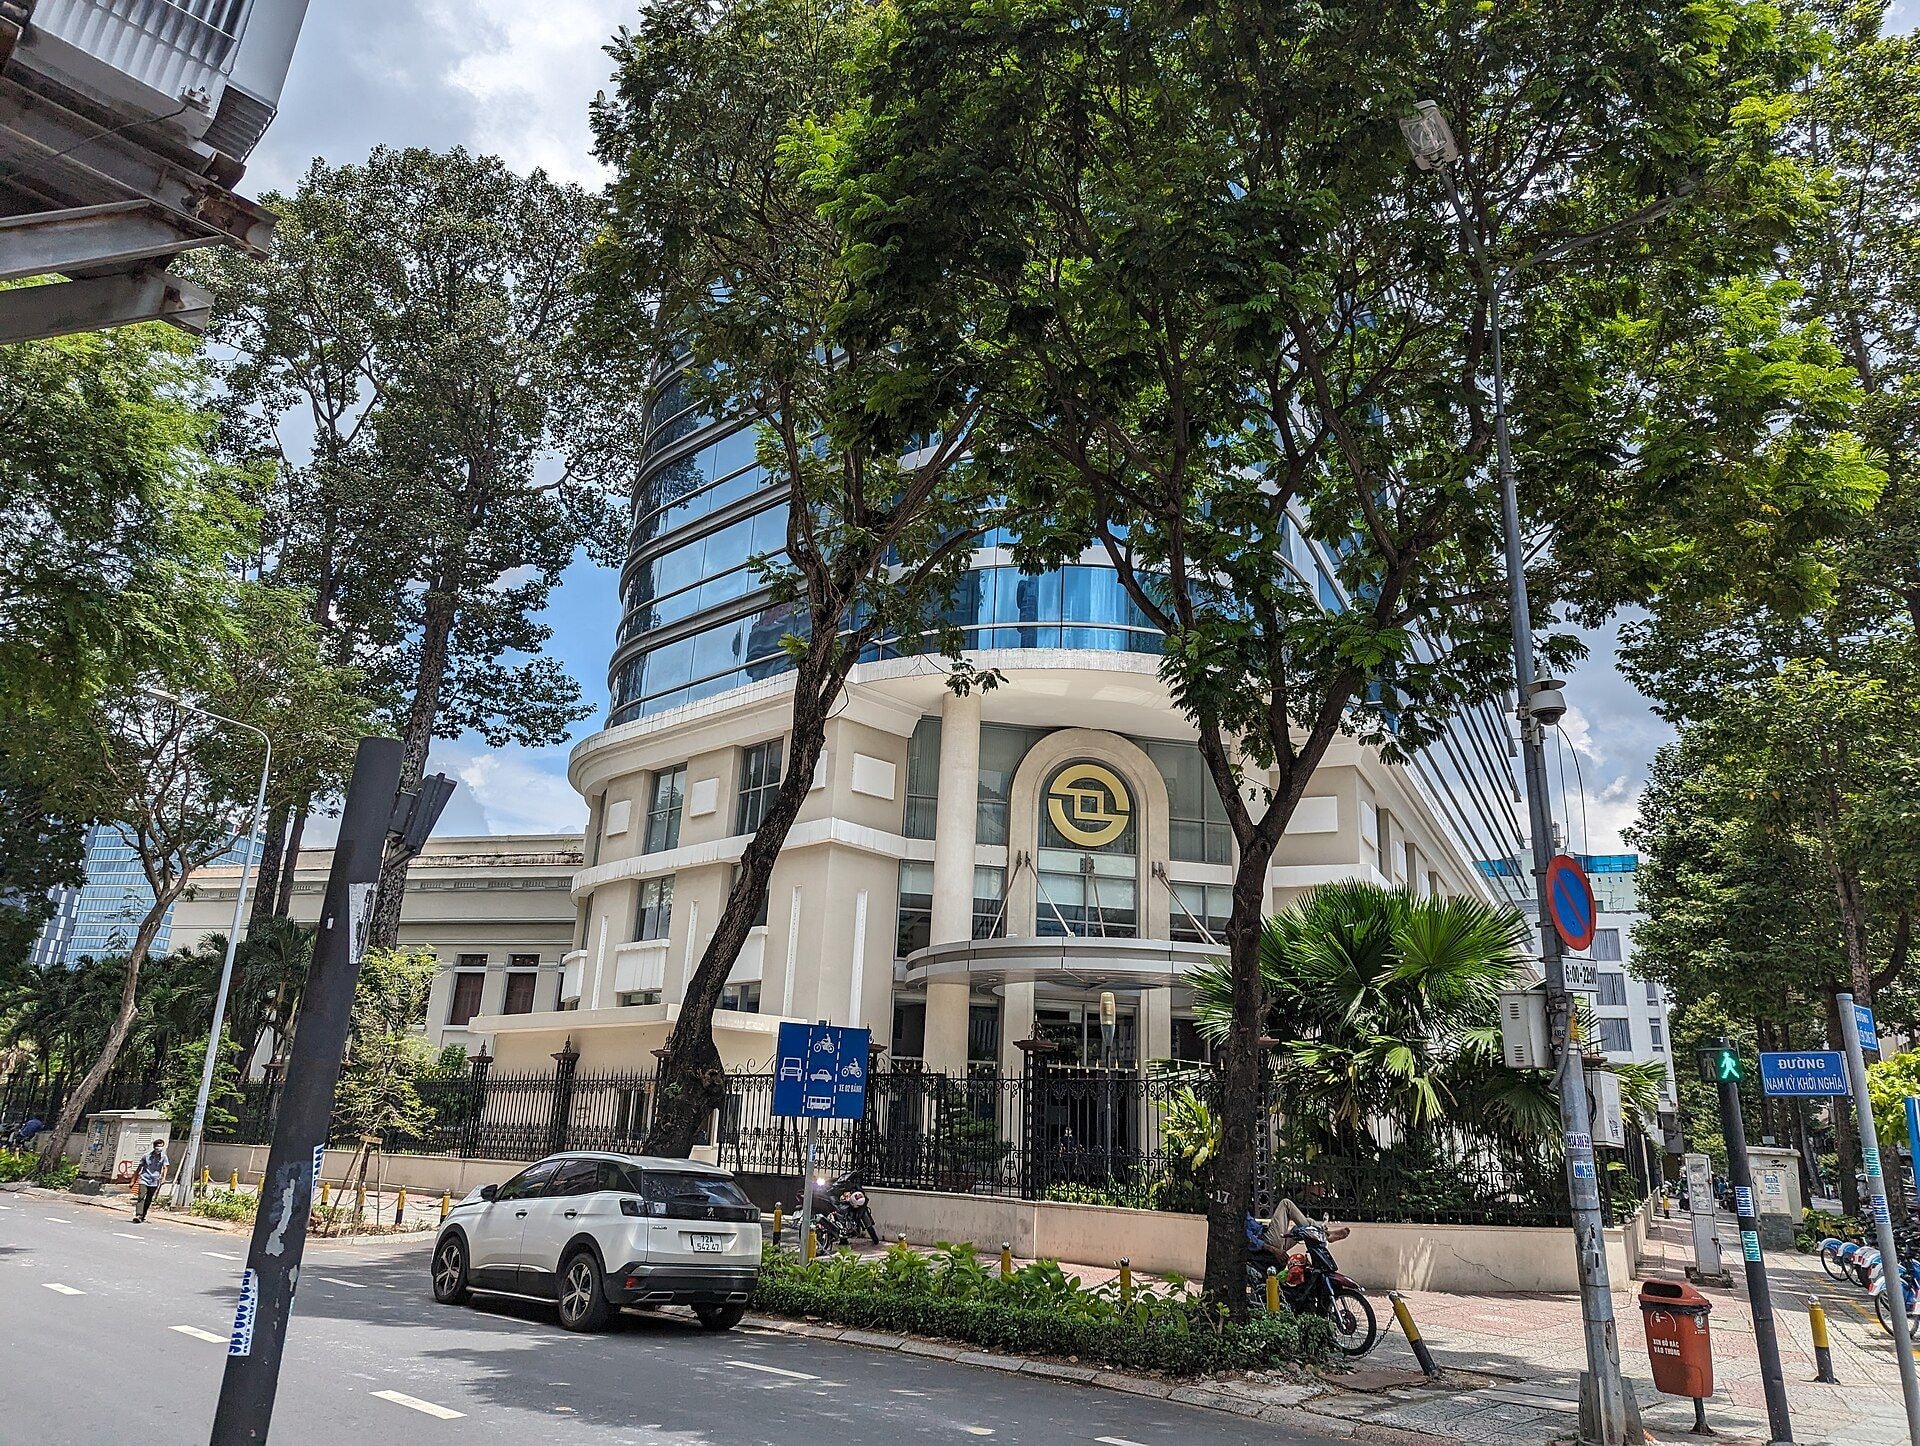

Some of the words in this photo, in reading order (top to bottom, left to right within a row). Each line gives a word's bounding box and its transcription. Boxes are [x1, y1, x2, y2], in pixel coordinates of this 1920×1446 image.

[1778, 1056, 1825, 1069] ĐƯỜNG
[1766, 1077, 1784, 1090] NAM
[1785, 1074, 1796, 1090] KỲ
[1798, 1072, 1817, 1090] KHỞI
[1818, 1074, 1844, 1090] NGHĨA
[1216, 1190, 1230, 1204] 17
[700, 1235, 713, 1243] 72A
